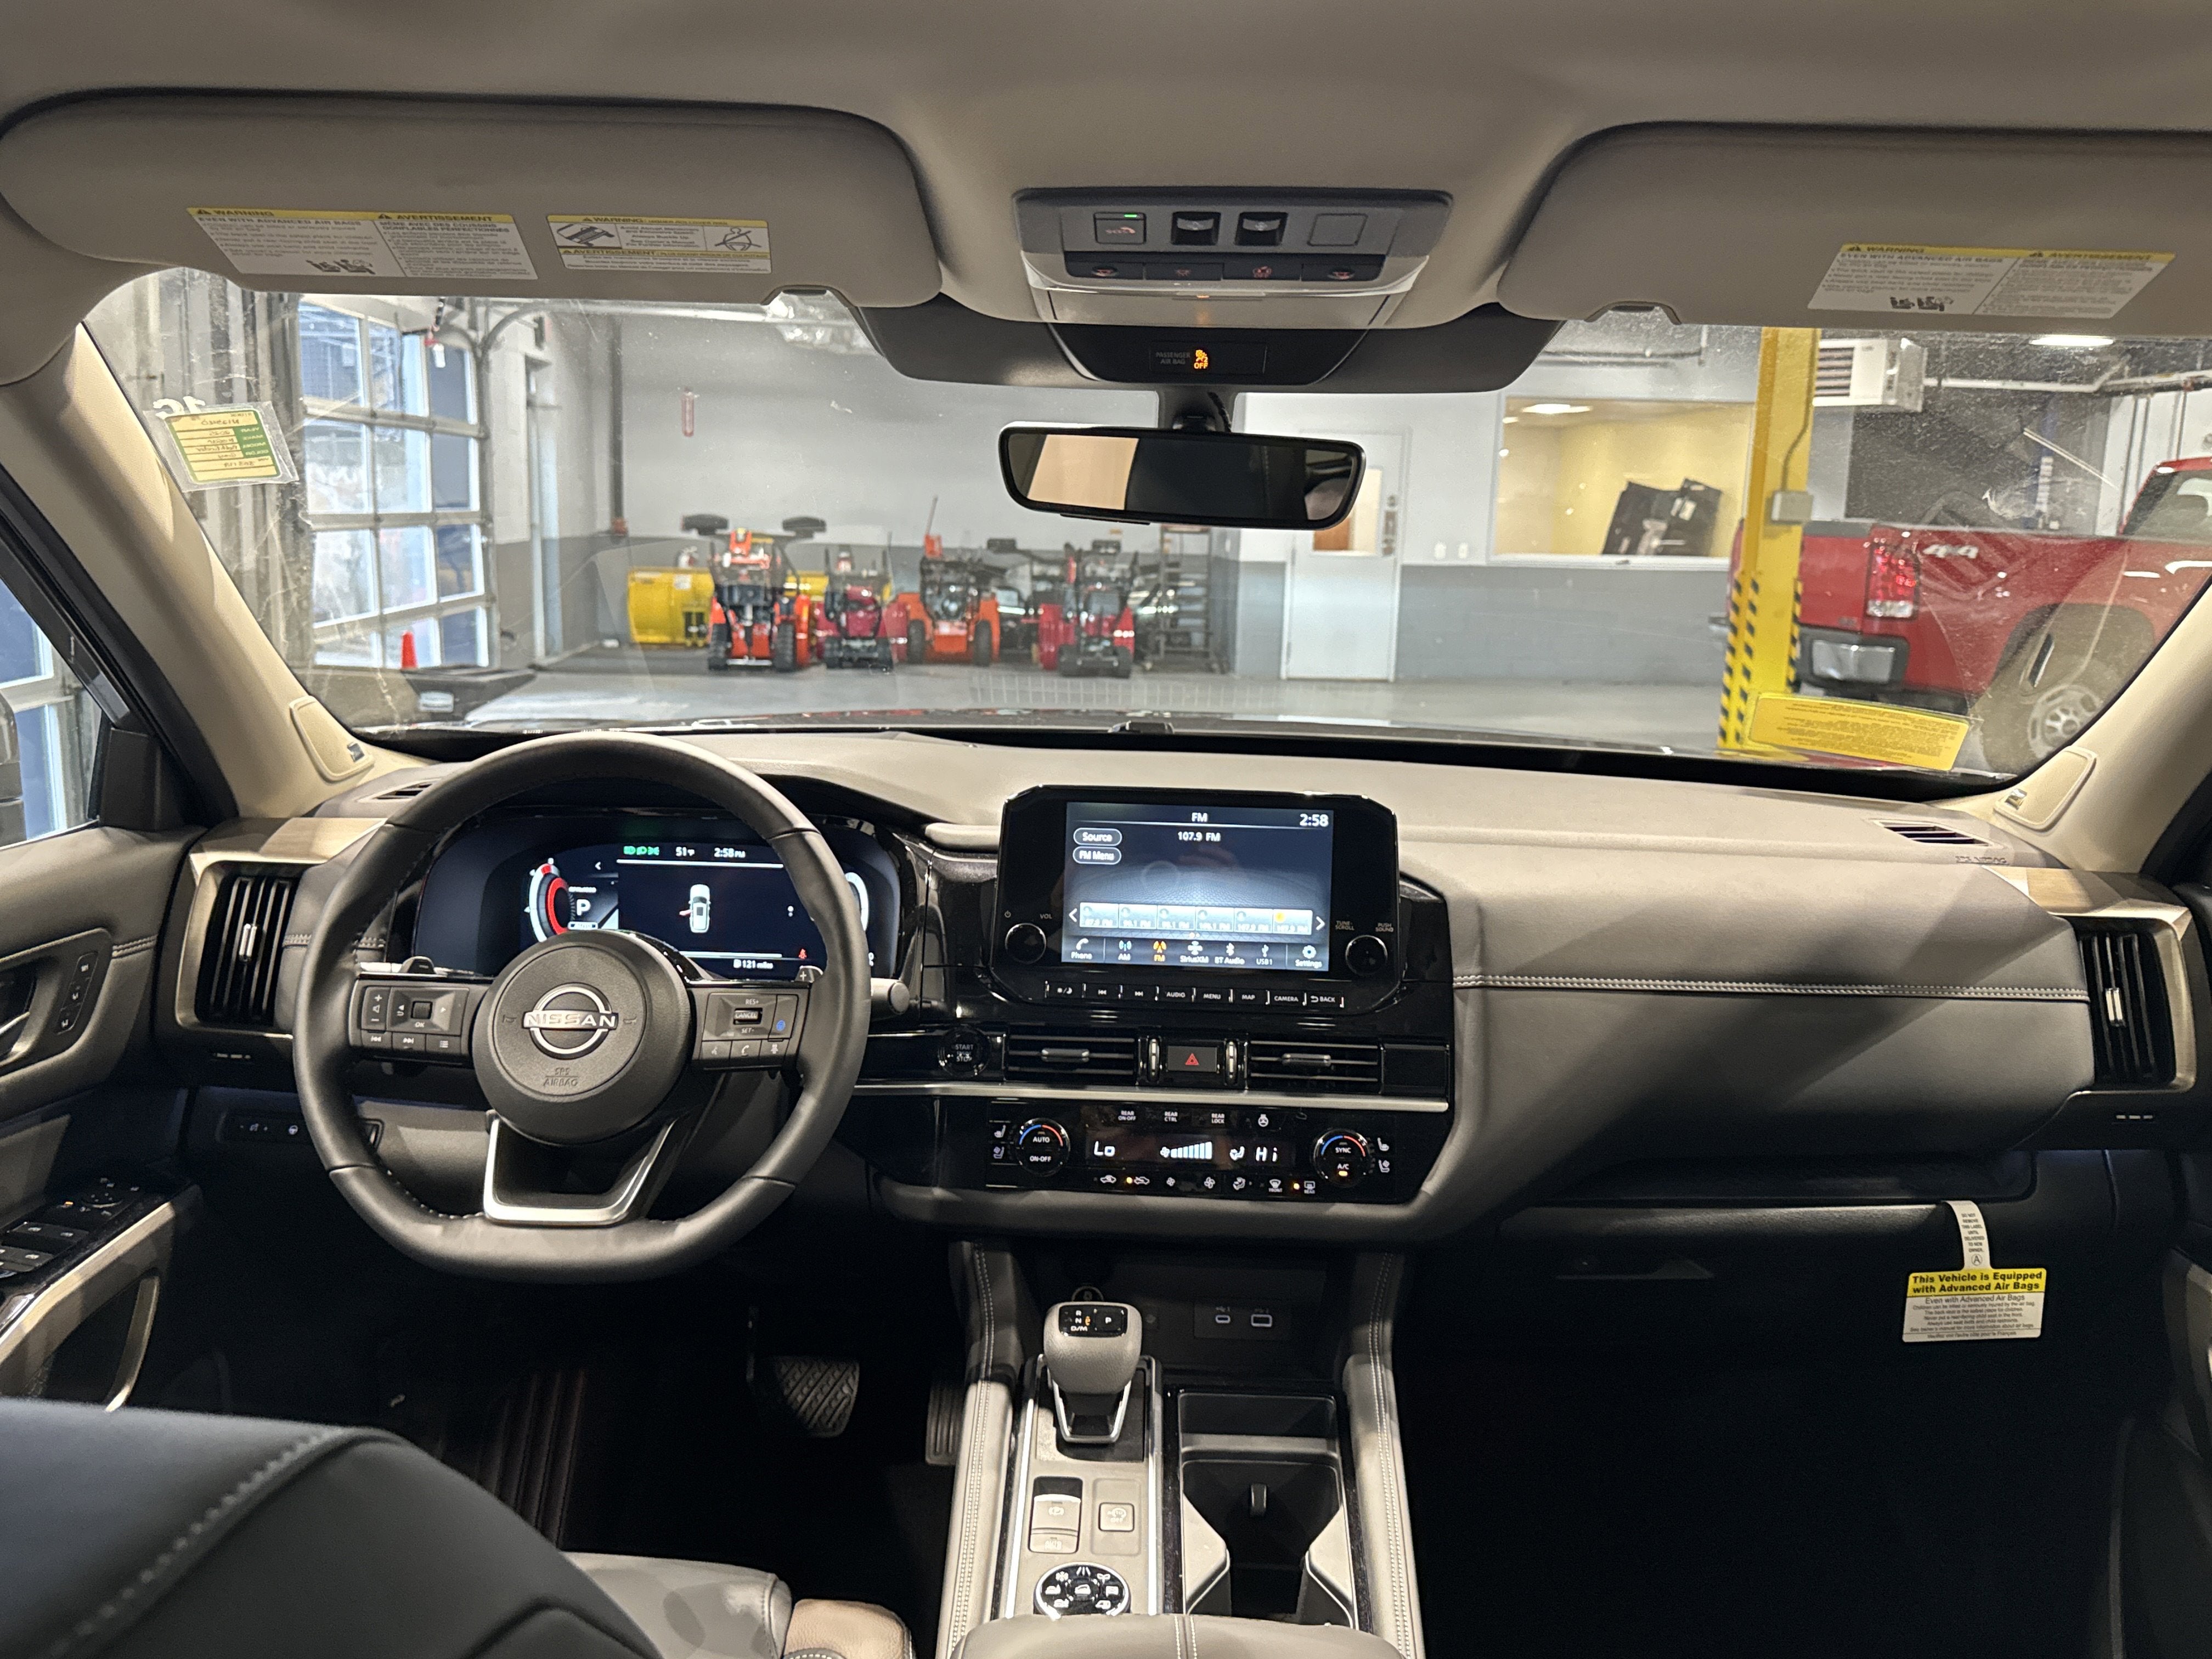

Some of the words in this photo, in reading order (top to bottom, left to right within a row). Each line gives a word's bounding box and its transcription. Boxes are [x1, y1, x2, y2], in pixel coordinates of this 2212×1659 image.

[1191, 812, 1209, 822] FM
[1299, 814, 1329, 827] 2:58
[1082, 831, 1113, 842] Source
[1177, 831, 1202, 841] 107.9
[1205, 832, 1221, 842] FM
[1079, 850, 1091, 860] FM
[1093, 851, 1115, 861] Menu
[577, 899, 591, 916] P
[1070, 951, 1093, 960] Phone
[1118, 953, 1131, 961] AM
[1153, 954, 1166, 962] FM
[1224, 957, 1245, 965] Audio
[742, 960, 756, 968] 121
[1295, 958, 1323, 969] Settings
[526, 1013, 616, 1028] NISSAN
[544, 1078, 578, 1087] AIRBAG
[1093, 1141, 1115, 1157] Lo
[1255, 1146, 1278, 1162] Hi
[1912, 1275, 1934, 1284] This
[1938, 1273, 1977, 1282] Vehicle
[1980, 1272, 1989, 1280] is
[1993, 1271, 2042, 1281] Equipped
[1913, 1285, 1936, 1294] with
[1939, 1283, 1991, 1293] Advanced
[1994, 1282, 2010, 1290] Air
[2013, 1282, 2039, 1291] Bags
